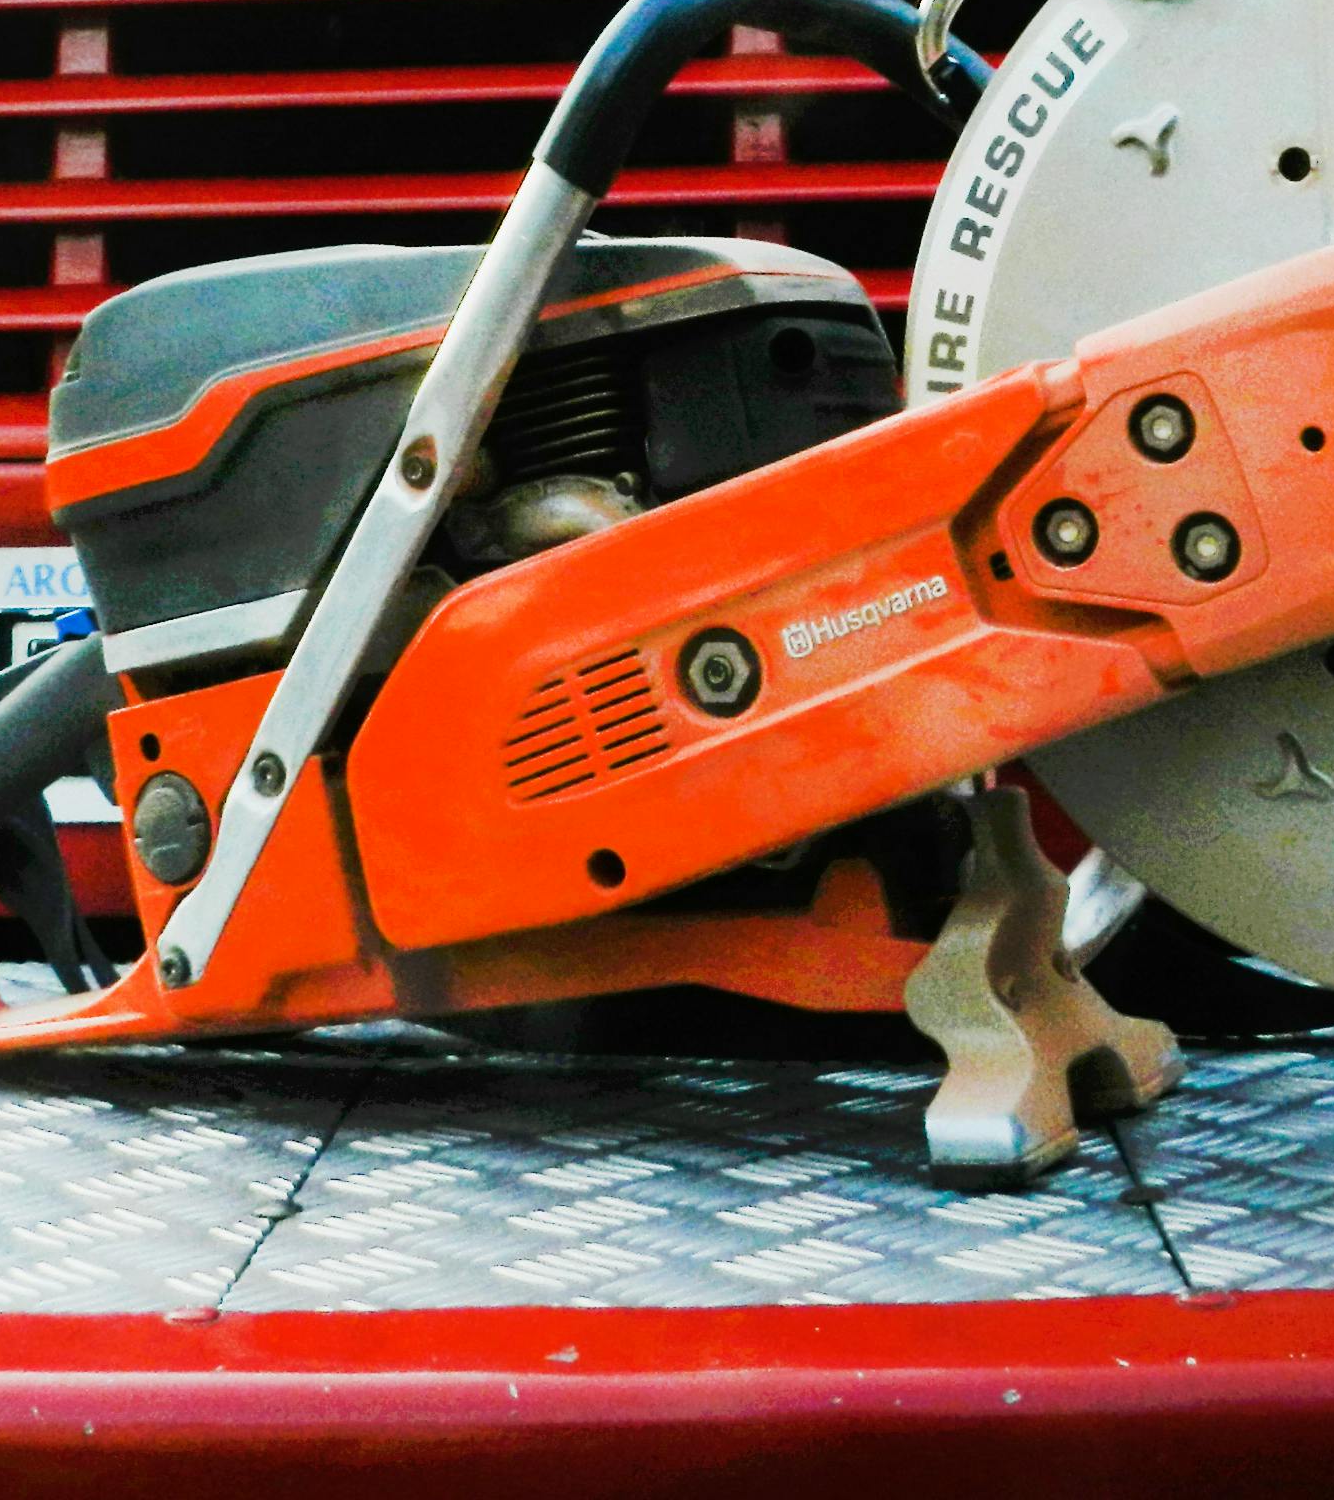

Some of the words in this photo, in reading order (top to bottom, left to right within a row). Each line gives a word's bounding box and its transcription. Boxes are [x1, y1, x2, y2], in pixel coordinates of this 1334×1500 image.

[949, 18, 1105, 262] RESCUE
[926, 288, 974, 393] IRE
[811, 575, 948, 645] Husqvarna
